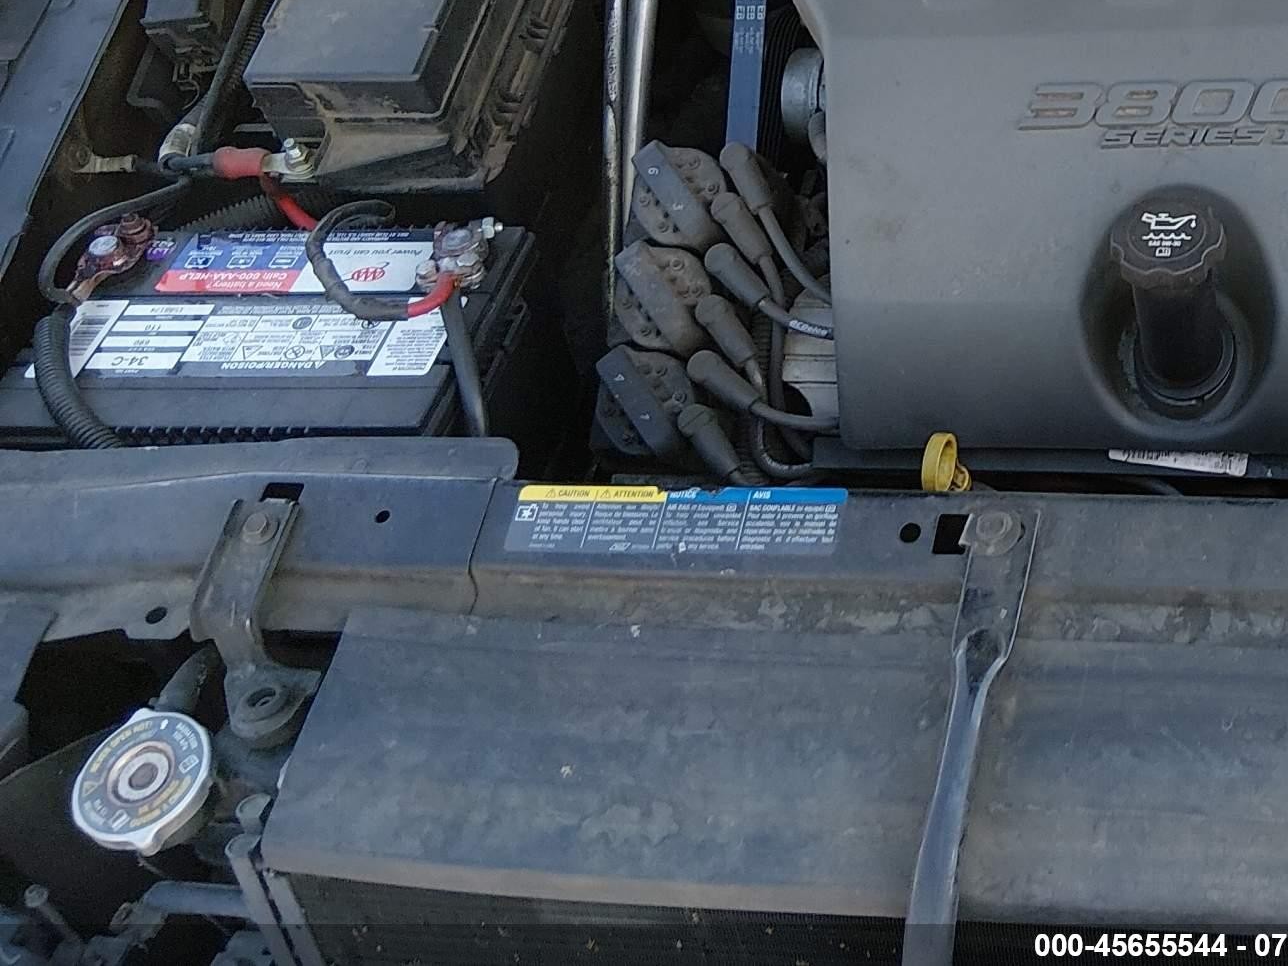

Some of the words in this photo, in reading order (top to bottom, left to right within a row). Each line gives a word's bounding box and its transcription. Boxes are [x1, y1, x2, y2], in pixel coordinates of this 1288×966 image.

[736, 6, 745, 20] EB
[756, 6, 765, 20] EB
[1101, 126, 1266, 149] SERIES
[329, 247, 351, 257] trust
[354, 248, 370, 256] can
[372, 248, 391, 257] you
[353, 267, 384, 281] AAA
[259, 281, 283, 290] Need
[112, 356, 149, 366] 34-C
[221, 361, 313, 370] DANGER/POISON
[558, 489, 590, 497] CAUTION
[613, 490, 654, 498] ATTENTION
[669, 489, 697, 499] NOTICE
[752, 491, 771, 500] AVIS
